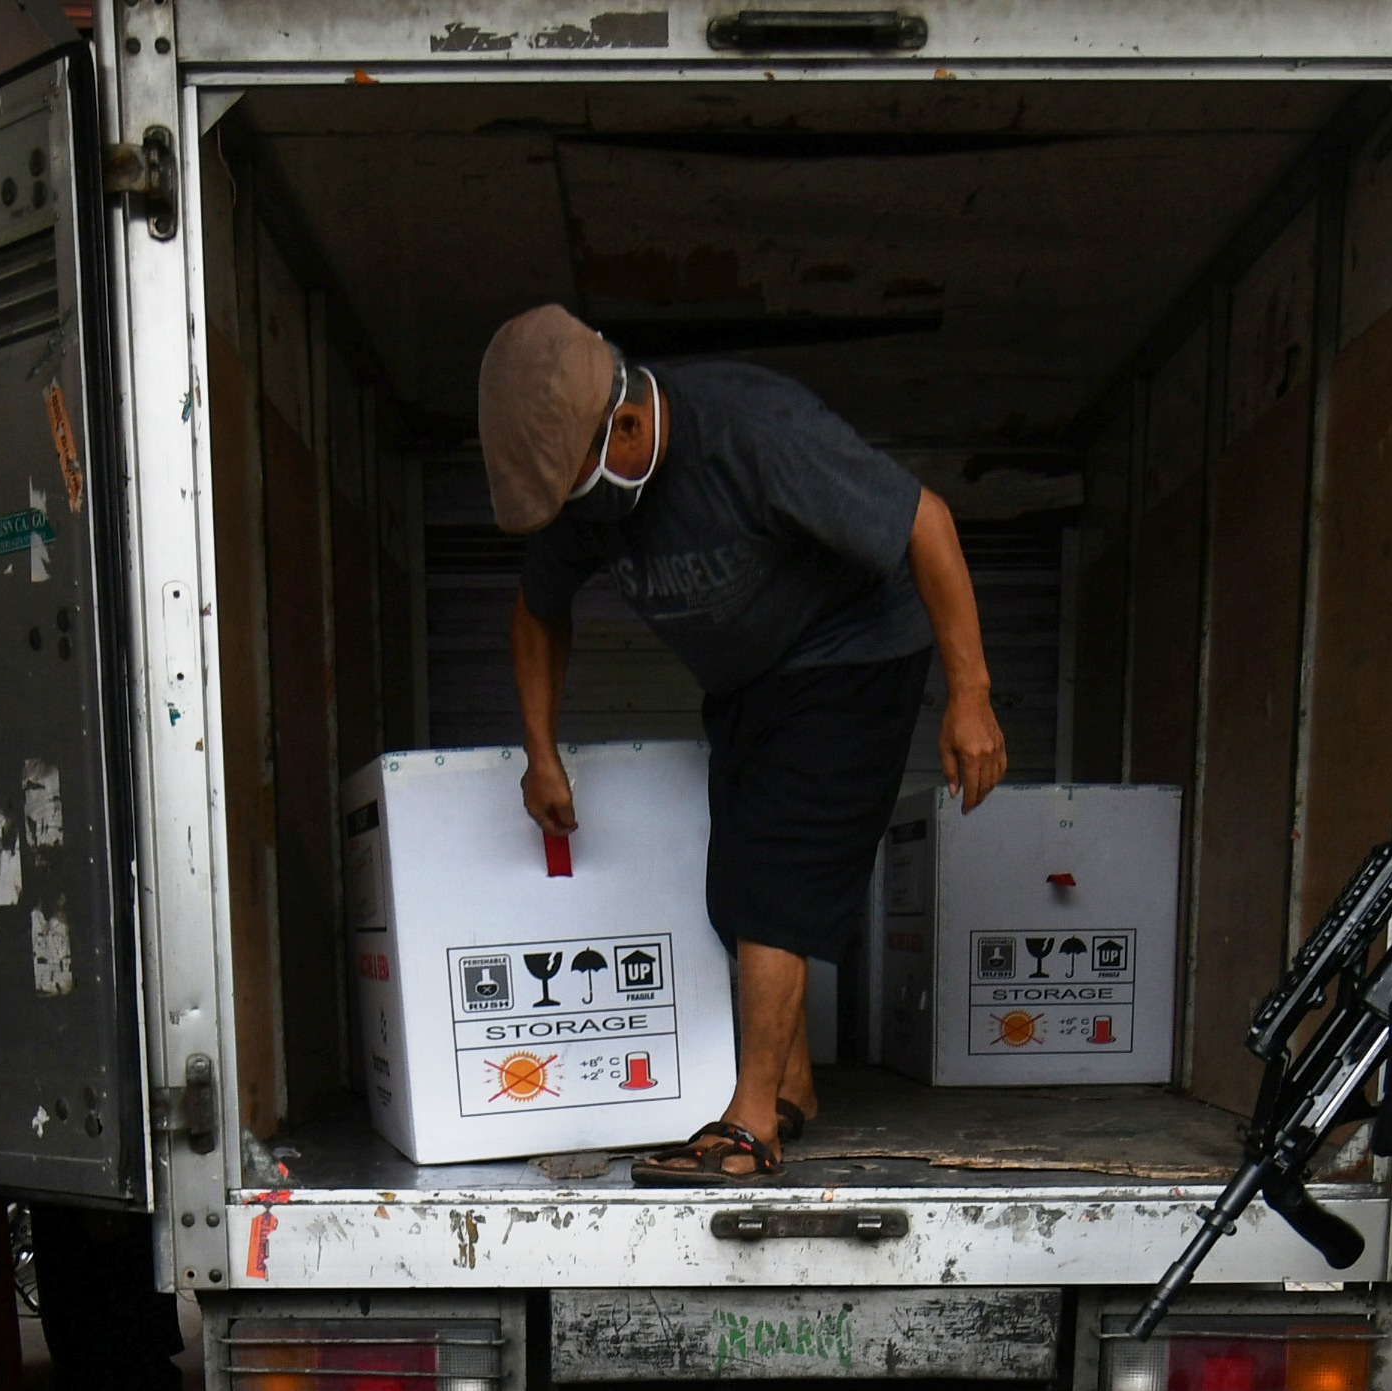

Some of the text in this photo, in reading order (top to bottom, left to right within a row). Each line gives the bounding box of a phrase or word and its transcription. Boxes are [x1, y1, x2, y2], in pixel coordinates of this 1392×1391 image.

[15, 513, 46, 532] CAGO
[463, 957, 507, 966] PERISHABLE
[1101, 950, 1119, 963] UP
[628, 963, 651, 981] UP
[626, 992, 655, 1002] FRAGILE
[991, 987, 1114, 1002] STORAGE
[469, 1001, 509, 1010] RUSH
[485, 1014, 649, 1041] STORAGE
